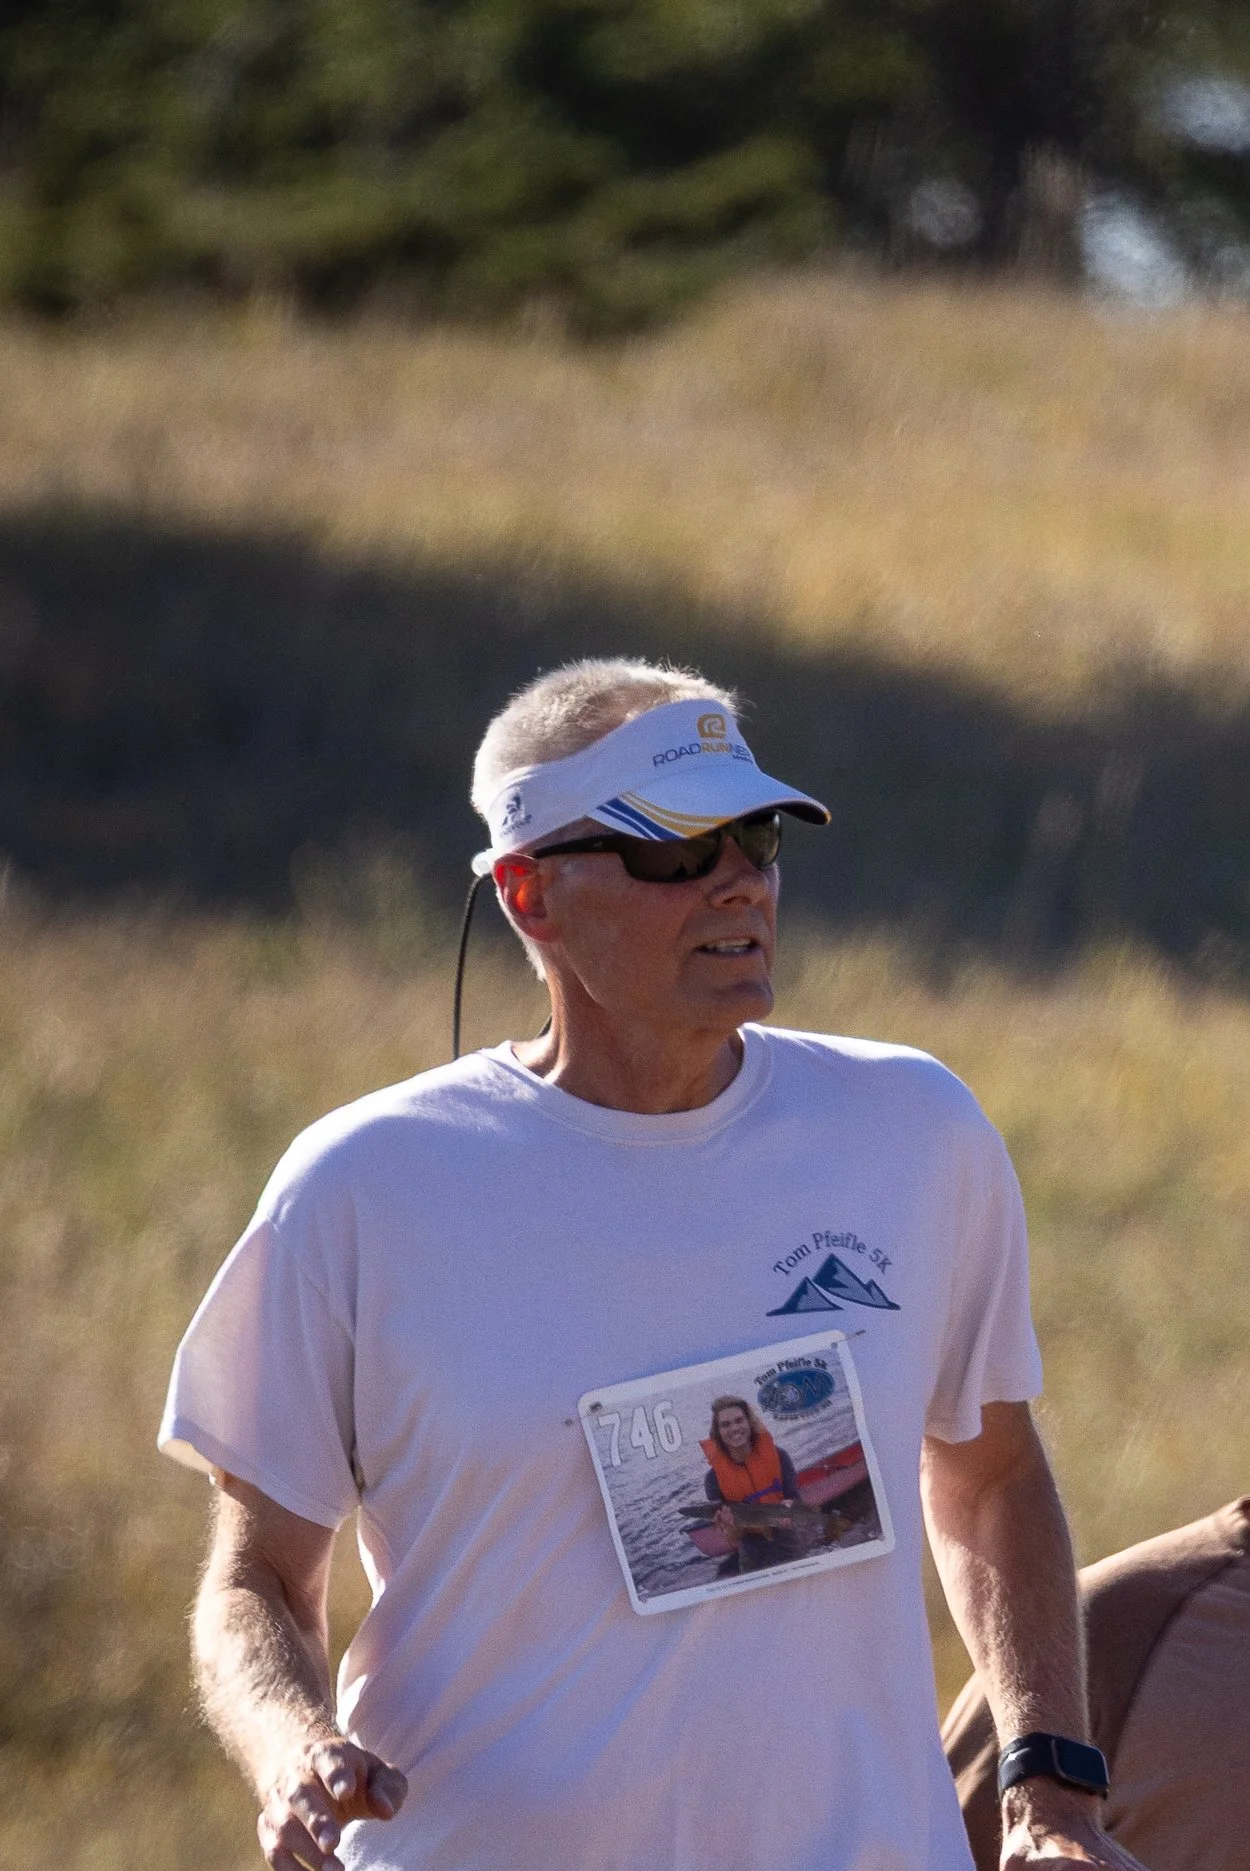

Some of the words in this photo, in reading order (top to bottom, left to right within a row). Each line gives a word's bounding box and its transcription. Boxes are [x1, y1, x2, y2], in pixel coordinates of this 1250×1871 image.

[773, 1244, 811, 1276] Tom
[811, 1230, 866, 1254] Pfeifle
[597, 1400, 683, 1469] 746
